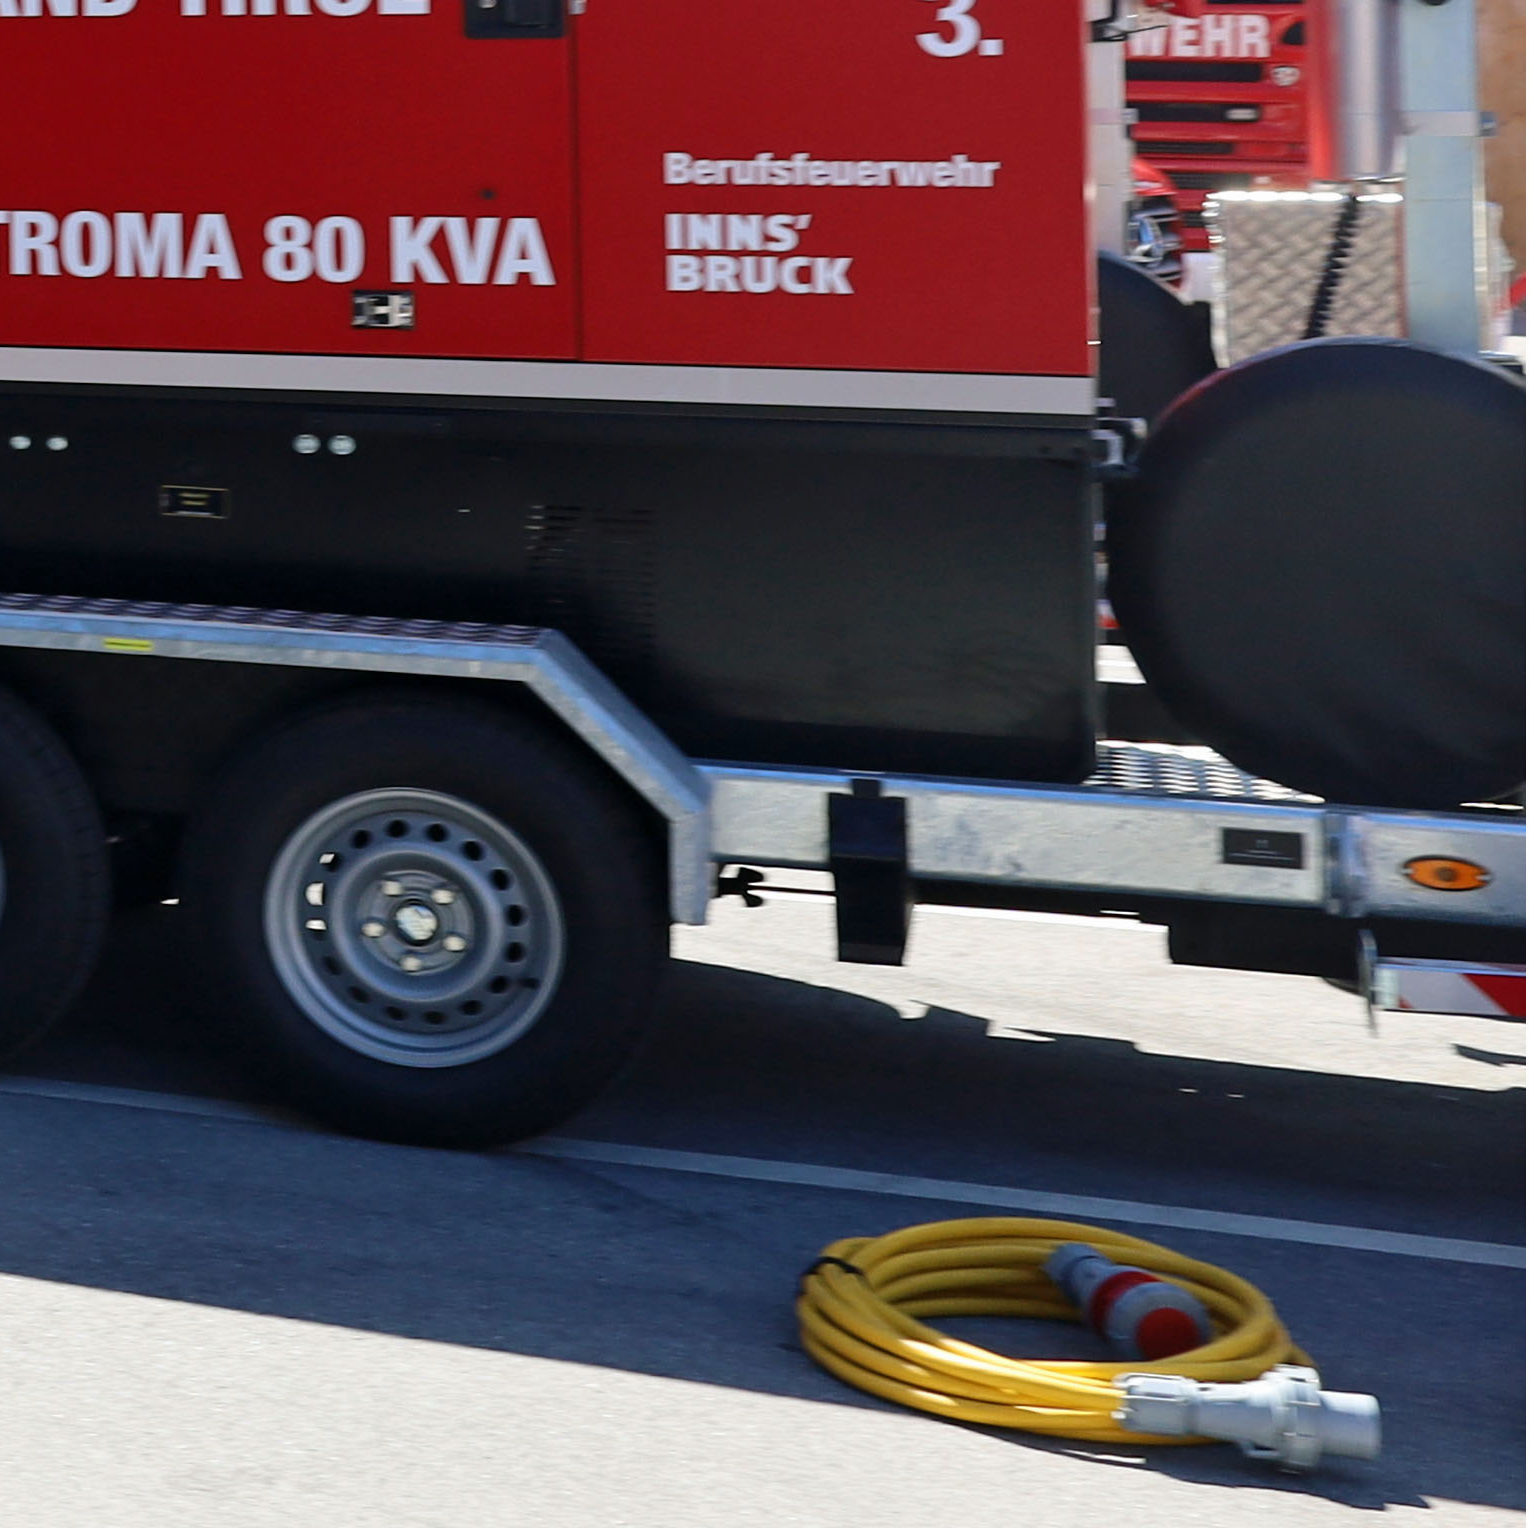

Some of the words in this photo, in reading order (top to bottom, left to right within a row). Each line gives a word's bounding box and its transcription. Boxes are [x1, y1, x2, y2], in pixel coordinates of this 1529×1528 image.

[662, 152, 1001, 187] Berufsfeuerwehr
[263, 215, 365, 283] 80
[389, 216, 556, 285] KVA
[666, 254, 854, 294] BRUCK
